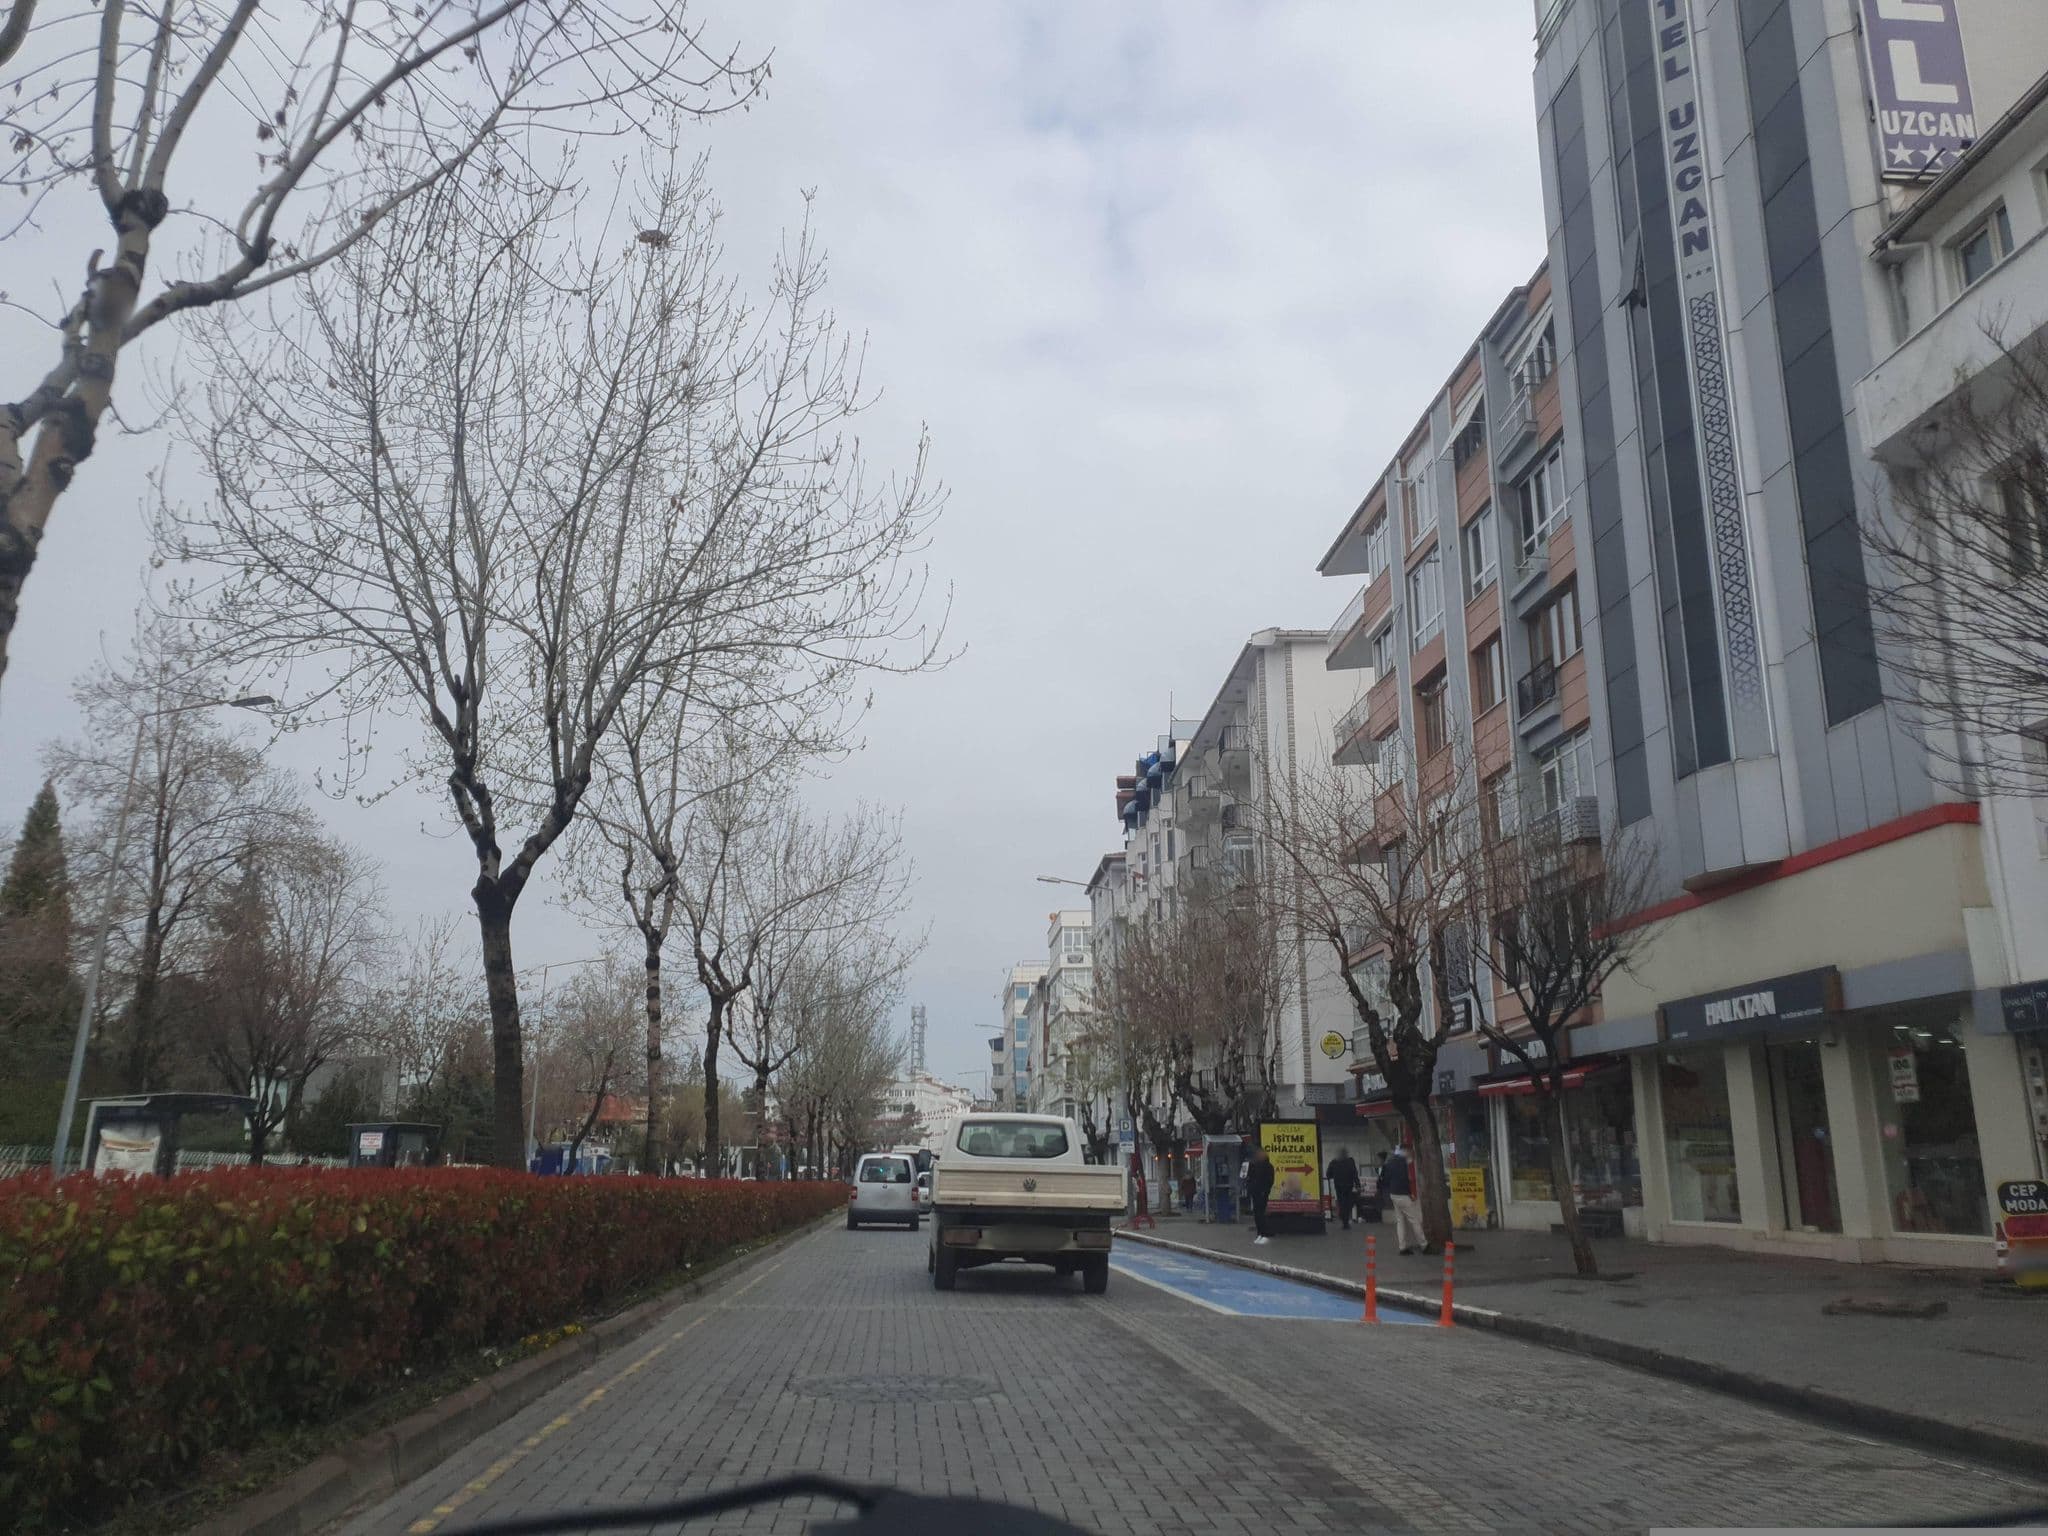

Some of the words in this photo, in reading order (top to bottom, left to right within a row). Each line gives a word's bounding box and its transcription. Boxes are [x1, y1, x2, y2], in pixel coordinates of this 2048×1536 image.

[1881, 110, 1975, 138] UZCAN
[1668, 101, 1709, 258] UZCAN
[1704, 991, 1776, 1026] HALKTAN
[1273, 1134, 1305, 1144] İŞİTME
[1264, 1143, 1315, 1153] CİHAZLARI
[2009, 1184, 2037, 1197] CEP
[2005, 1199, 2048, 1212] MODA
